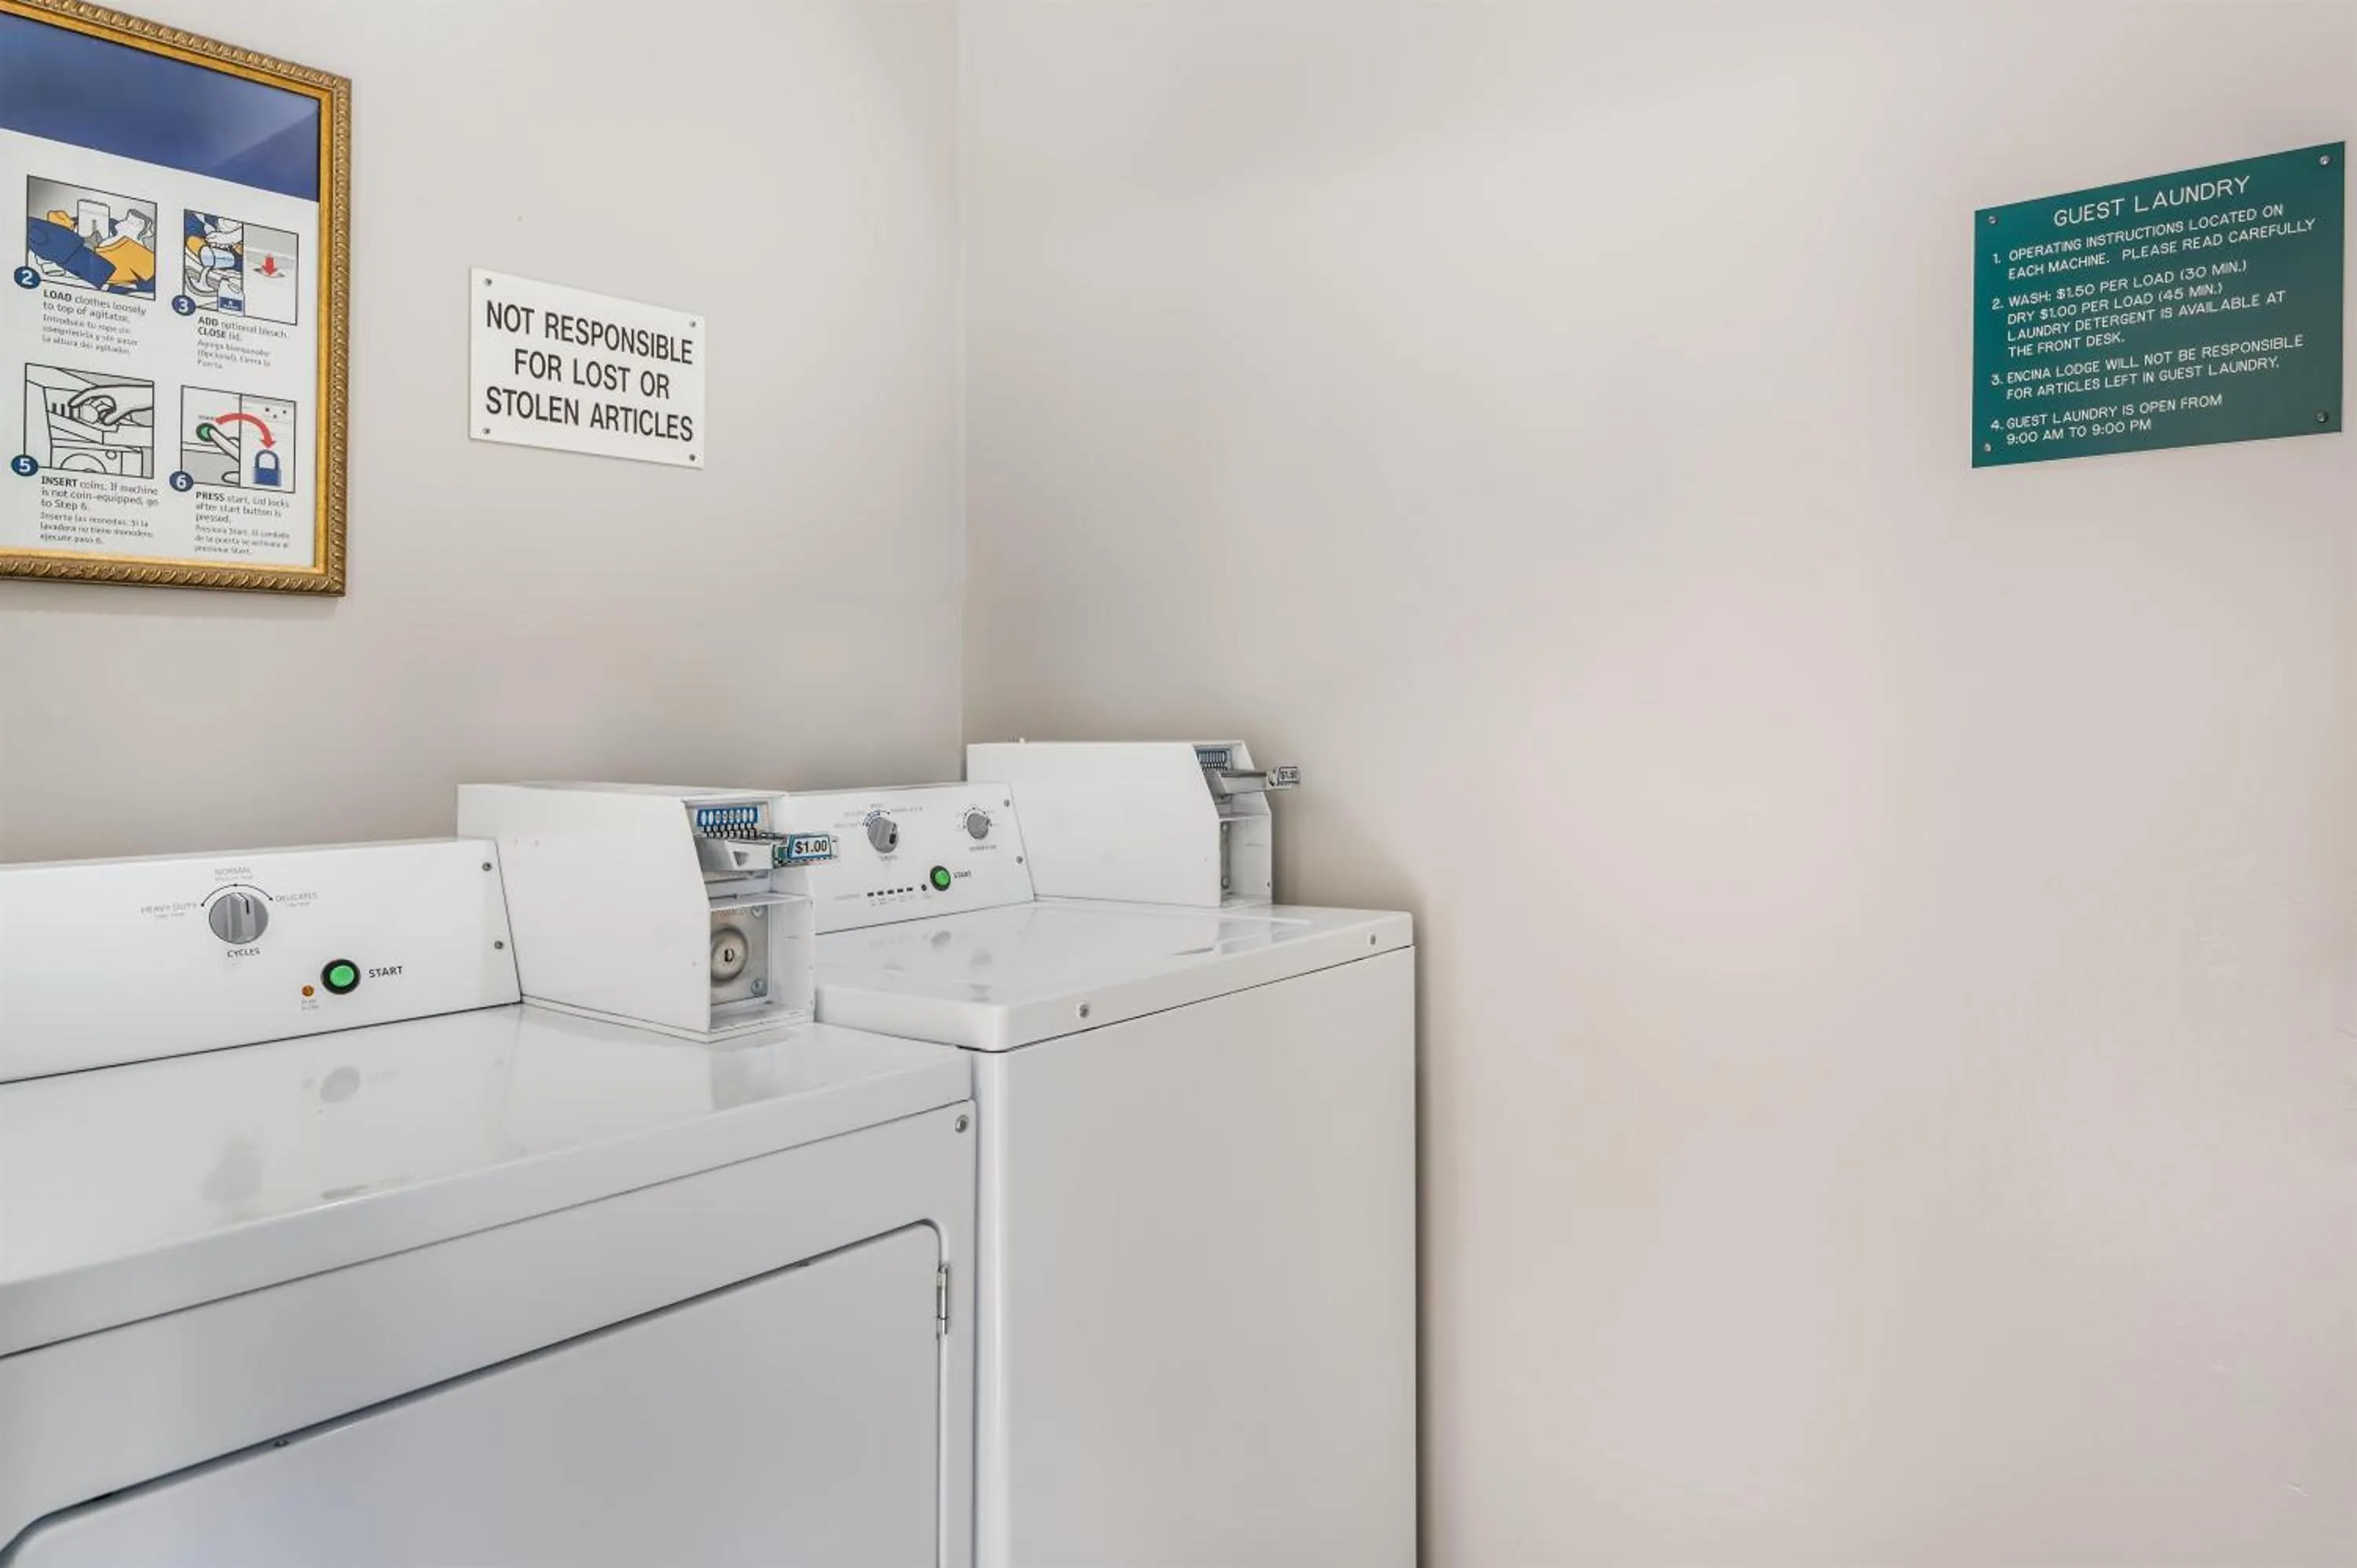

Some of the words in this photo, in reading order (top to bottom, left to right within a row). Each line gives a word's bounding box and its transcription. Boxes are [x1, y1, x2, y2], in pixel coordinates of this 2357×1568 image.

[2054, 197, 2124, 226] GUEST
[2135, 175, 2250, 212] LAUNDRY
[1992, 253, 2001, 264] 1.
[2009, 238, 2082, 262] OPERATING
[2086, 221, 2183, 248] INSTRUCTIONS
[2189, 208, 2257, 230] LOCATED
[2262, 203, 2284, 218] ON
[2008, 263, 2044, 280] EACH
[2048, 252, 2110, 273] MACHINE.
[2122, 241, 2177, 261] PLEASE
[2183, 234, 2223, 251] READ
[2228, 218, 2315, 244] CAREFULLY
[21, 269, 32, 285] 2
[1992, 298, 2003, 310] 2.
[2008, 290, 2051, 307] WASH:
[2056, 284, 2095, 300] $1.50
[2099, 278, 2128, 293] PER
[2133, 271, 2174, 288] LOAD
[2180, 266, 2206, 280] (30
[2212, 260, 2247, 276] MIN.)
[43, 289, 71, 301] LOAD
[75, 294, 110, 309] clothes
[112, 301, 147, 316] loosely
[43, 301, 53, 310] to
[57, 304, 74, 314] top
[178, 298, 189, 312] 3
[2007, 311, 2035, 325] DRY
[2040, 304, 2077, 320] $1.00
[2081, 299, 2110, 313] PER
[2114, 292, 2154, 309] LOAD
[2158, 287, 2183, 302] (45
[2189, 283, 2223, 298] MIN.)
[198, 317, 218, 327] ADD
[221, 321, 257, 333] optional
[2007, 321, 2070, 342] LAUNDRY
[2075, 309, 2156, 332] DETERGENT
[2161, 308, 2172, 320] IS
[2178, 294, 2260, 317] AVAILABLE
[2266, 290, 2286, 304] AT
[198, 327, 225, 339] CLOSE
[229, 332, 243, 341] lid.
[486, 300, 534, 335] NOT
[544, 312, 693, 365] RESPONSIBLE
[2008, 343, 2033, 357] THE
[2037, 337, 2081, 354] FRONT
[2086, 332, 2125, 347] DESK.
[1991, 374, 2003, 386] 3.
[2007, 367, 2051, 384] ENCINA
[2056, 361, 2099, 377] LODGE
[2105, 355, 2139, 370] WILL
[2144, 352, 2173, 365] NOT
[2178, 348, 2197, 362] BE
[2201, 334, 2304, 358] RESPONSIBLE
[515, 348, 562, 382] FOR
[573, 358, 630, 392] LOST
[640, 371, 669, 399] OR
[2006, 387, 2033, 400] FOR
[2037, 379, 2100, 397] ARTICLES
[2105, 373, 2138, 388] LEFT
[2143, 372, 2154, 383] IN
[2158, 365, 2203, 382] GUEST
[2209, 356, 2279, 376] LAUNDRY.
[486, 386, 579, 426] STOLEN
[590, 403, 693, 441] ARTICLES
[1991, 419, 2003, 430] 4.
[2006, 414, 2047, 430] GUEST
[2052, 405, 2117, 424] LAUNDRY
[2122, 404, 2135, 416] IS
[2139, 399, 2176, 414] OPEN
[2180, 394, 2223, 409] FROM
[2007, 432, 2039, 445] 9:00
[2042, 428, 2064, 441] AM
[2069, 425, 2087, 438] TO
[2091, 422, 2125, 436] 9:00
[2130, 419, 2152, 431] PM
[20, 458, 31, 471] 5
[42, 476, 79, 487] INSERT
[79, 481, 108, 490] coins.
[119, 485, 158, 496] machine
[176, 475, 185, 489] 6
[41, 499, 52, 507] to
[55, 500, 78, 511] Step
[42, 487, 49, 496] is
[51, 489, 68, 498] not
[70, 491, 144, 505] coin-equipped,
[145, 499, 159, 508] go
[196, 492, 225, 502] PRESS
[253, 497, 266, 506] Lid
[268, 498, 289, 508] locks
[220, 505, 240, 514] start
[244, 507, 273, 517] button
[795, 840, 828, 855] $1.00
[214, 866, 251, 875] NORMAL
[274, 892, 317, 903] DELICATES
[227, 947, 262, 958] CYCLES
[368, 966, 402, 978] START
